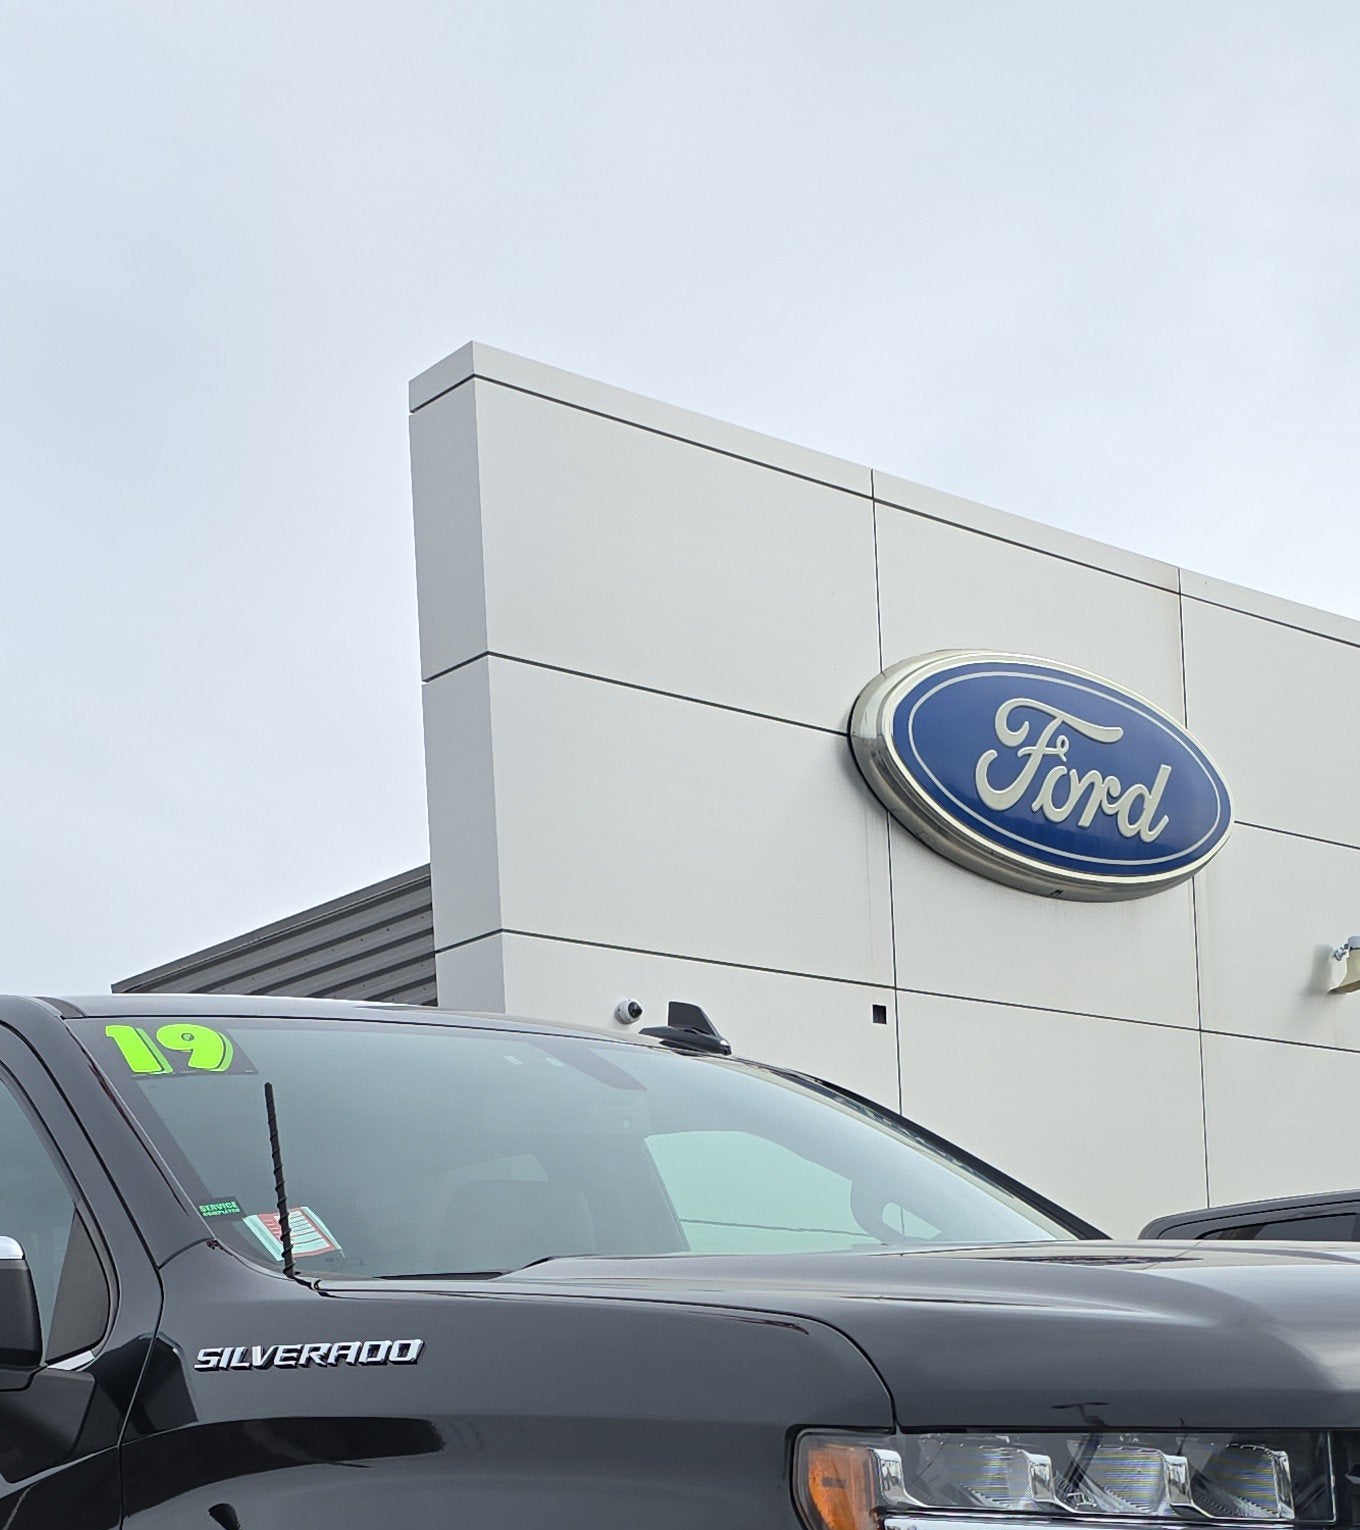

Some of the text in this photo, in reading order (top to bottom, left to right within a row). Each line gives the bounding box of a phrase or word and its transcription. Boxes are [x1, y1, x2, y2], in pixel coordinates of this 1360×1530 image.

[975, 698, 1171, 842] Ford
[105, 1023, 234, 1075] 19
[194, 1338, 425, 1371] SILVERADO
